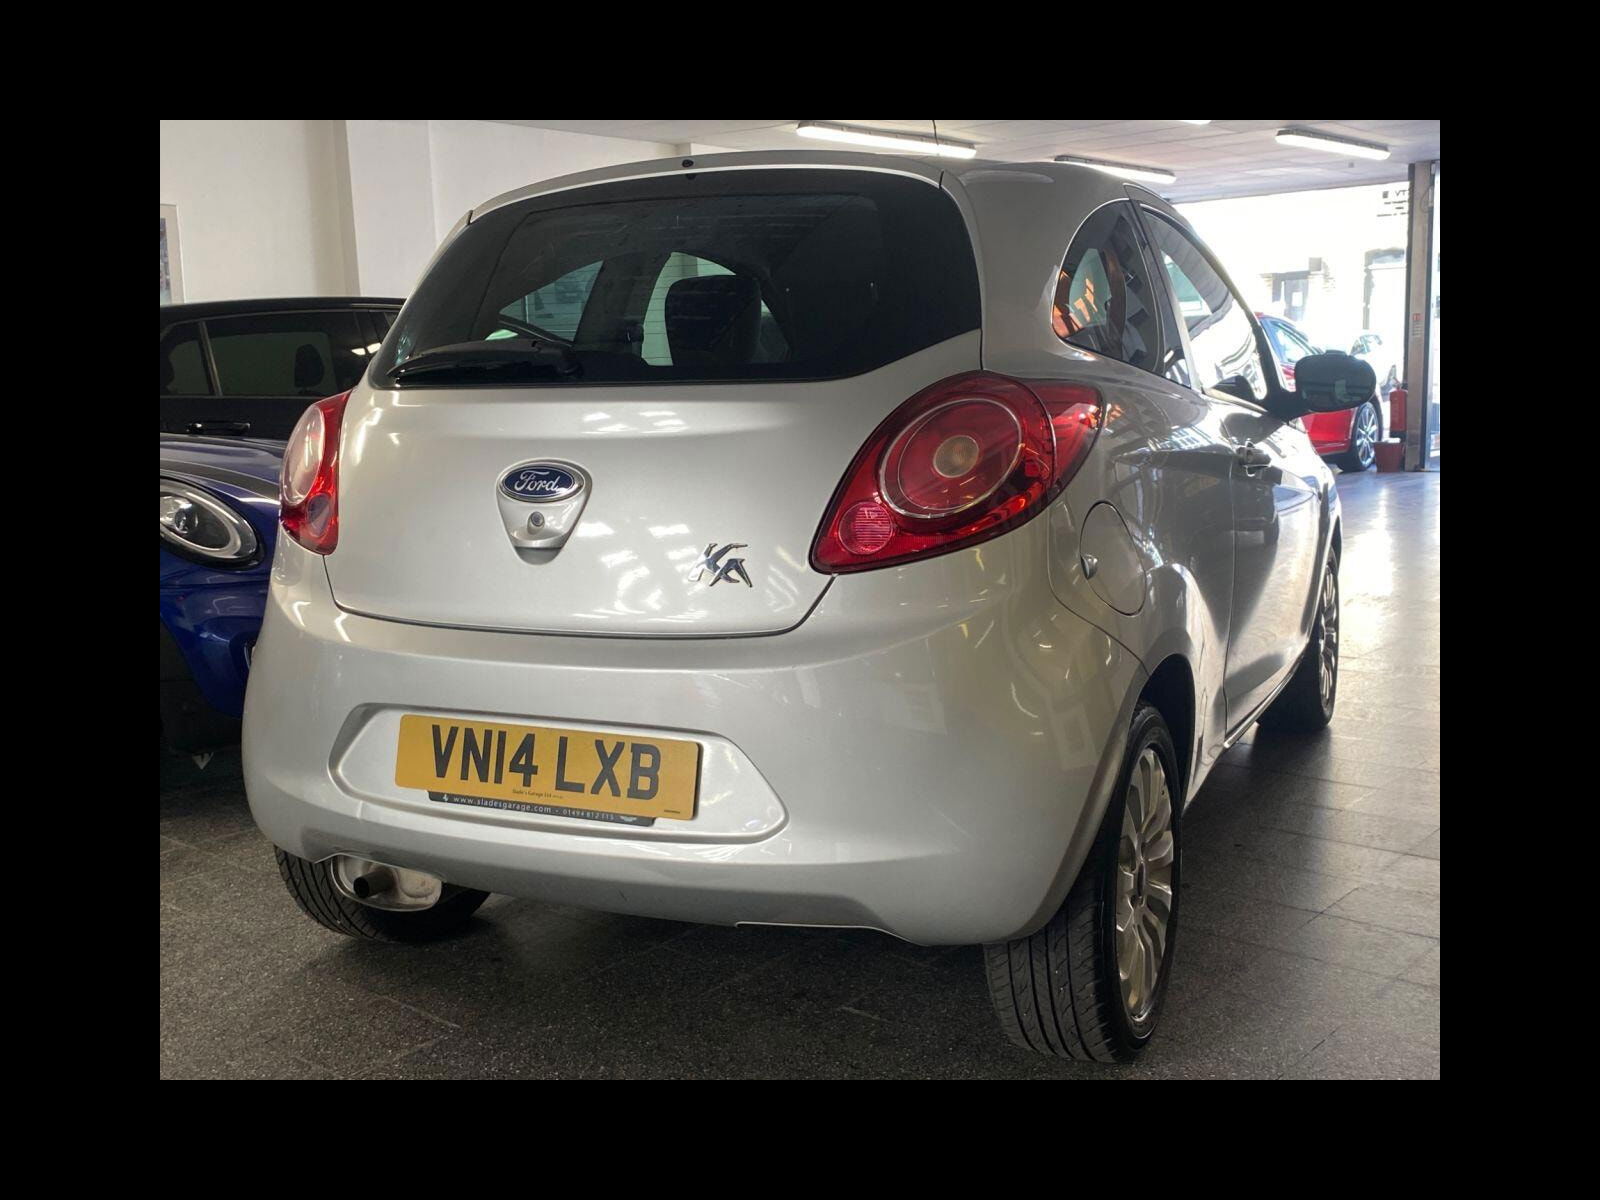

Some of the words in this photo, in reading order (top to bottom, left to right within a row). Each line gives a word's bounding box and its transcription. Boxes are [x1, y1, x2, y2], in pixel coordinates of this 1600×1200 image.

[514, 470, 560, 491] Ford
[431, 724, 539, 788] VN14
[554, 736, 662, 801] LXB
[453, 796, 552, 813] www.sladesgarage.com
